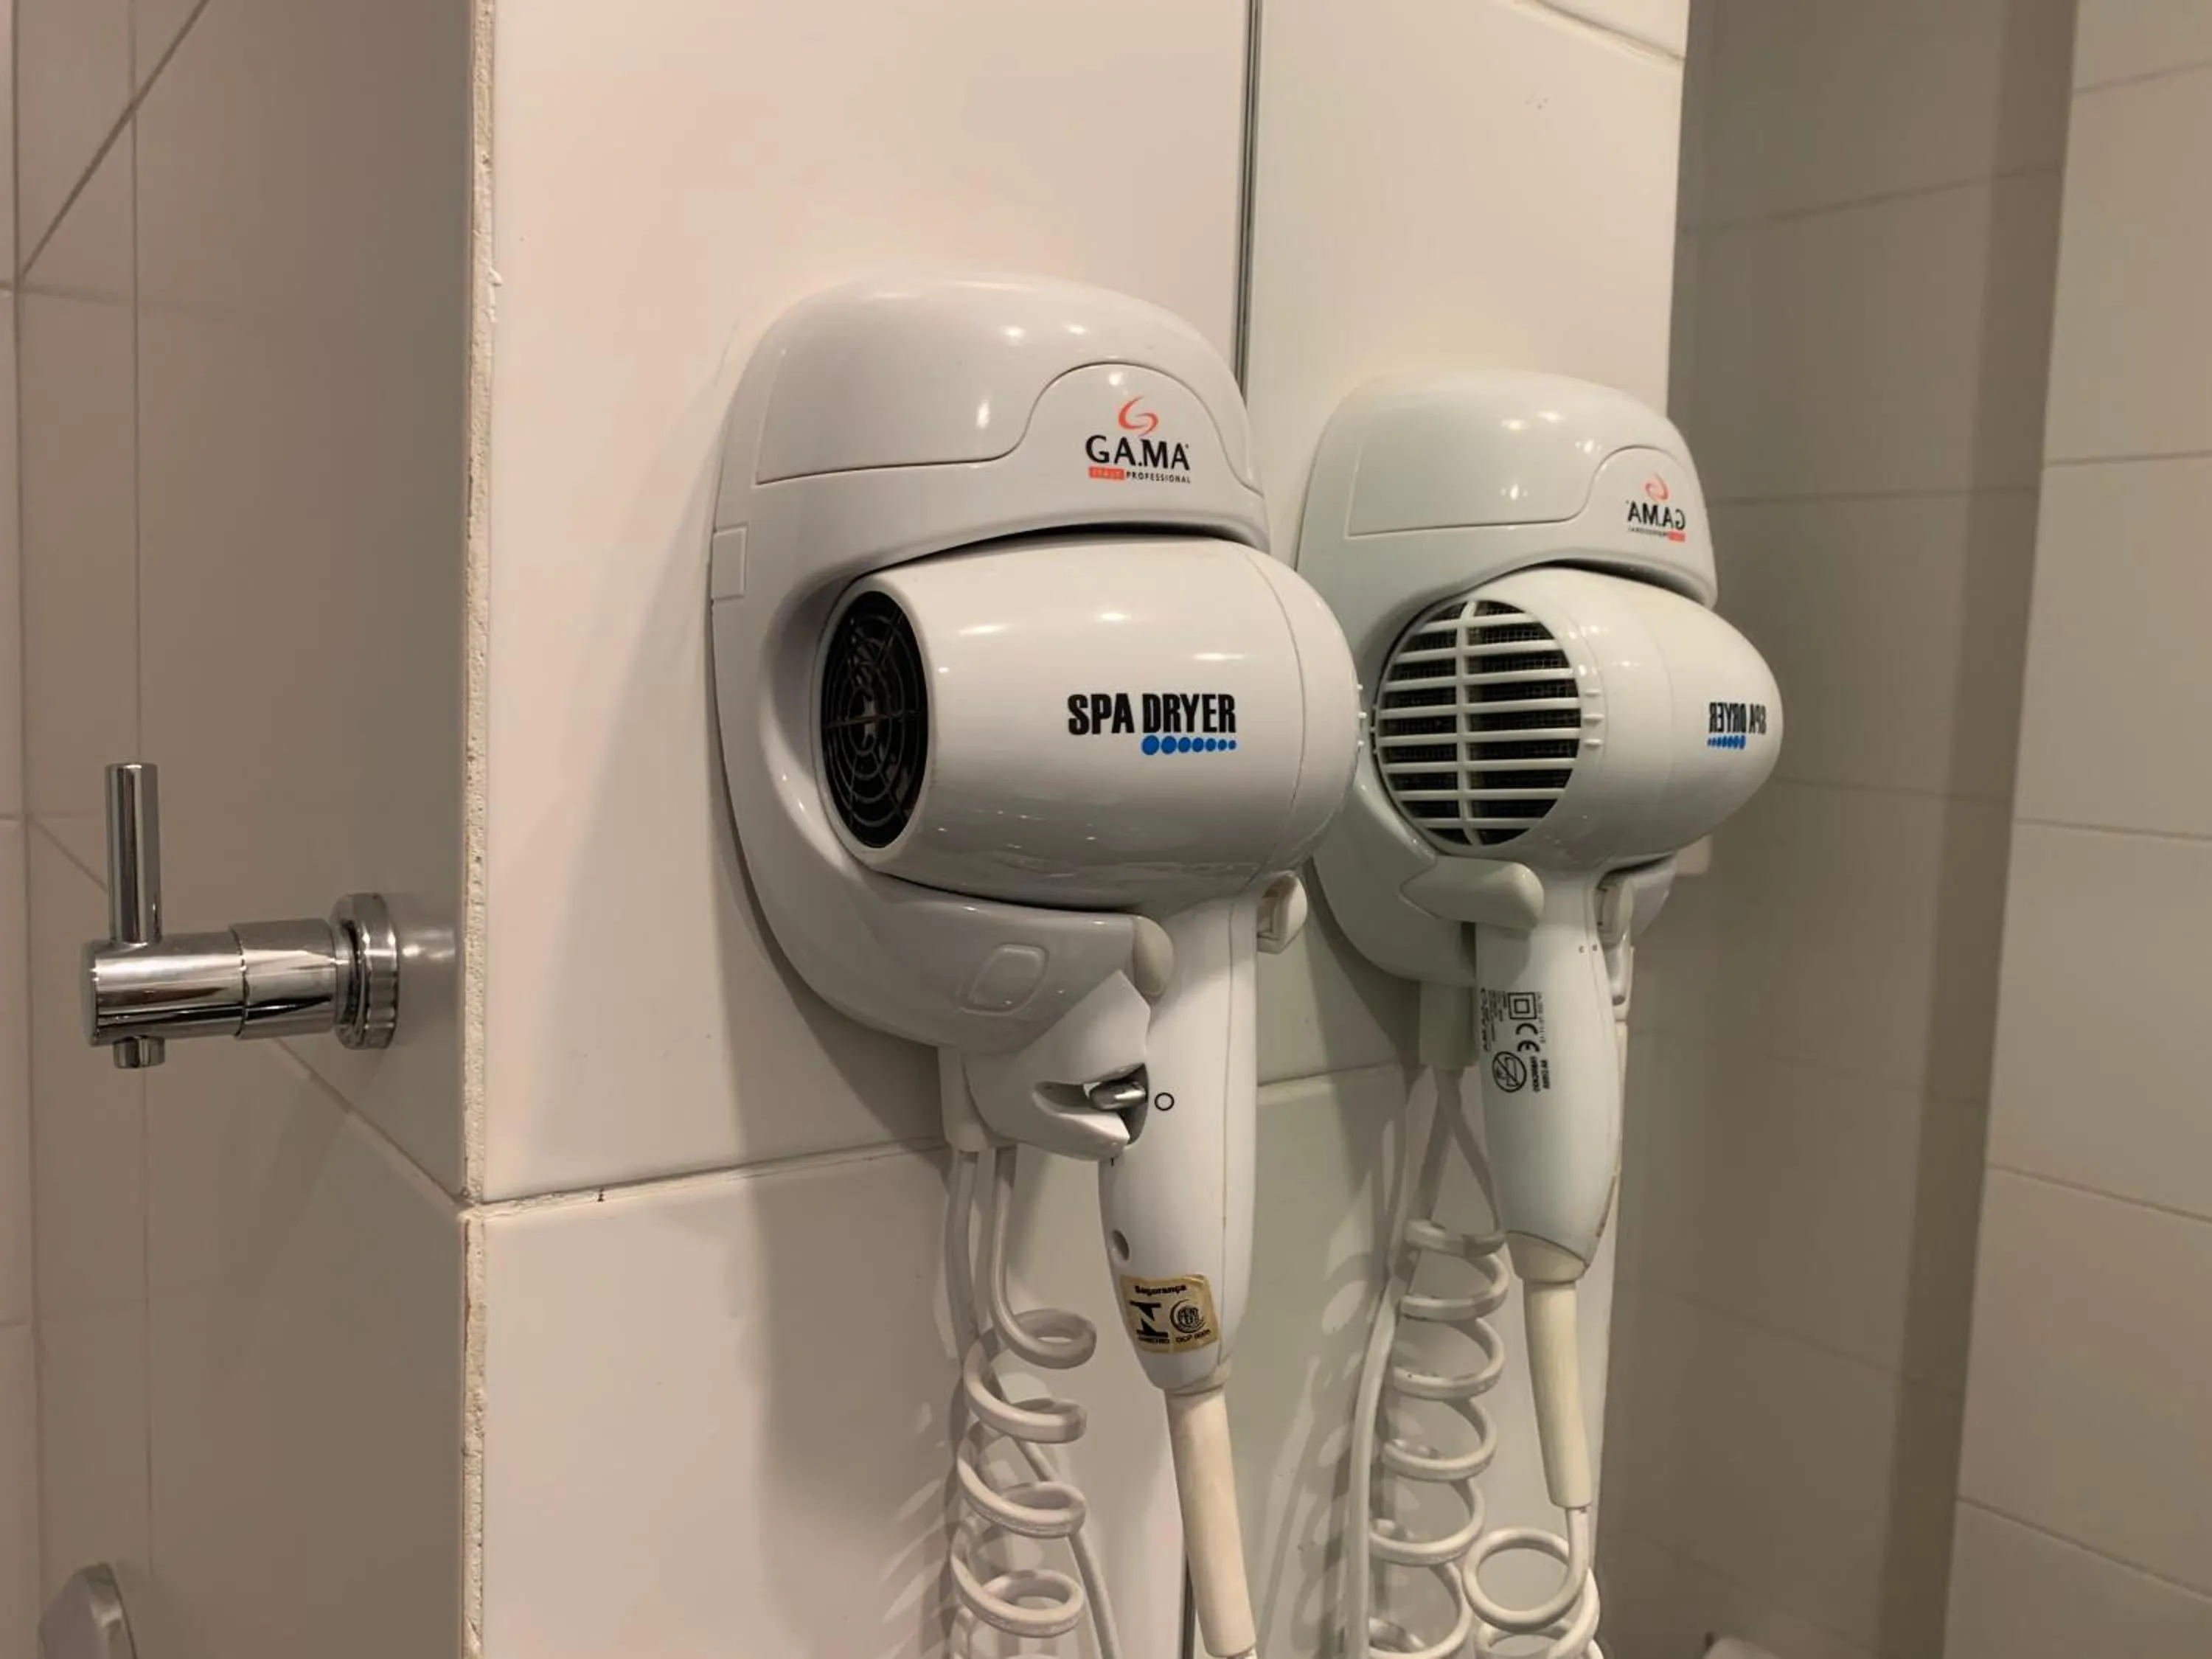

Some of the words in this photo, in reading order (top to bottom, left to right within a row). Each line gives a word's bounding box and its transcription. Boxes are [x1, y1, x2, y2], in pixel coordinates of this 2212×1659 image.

[1126, 471, 1191, 484] PROFESSIONAL
[1068, 693, 1135, 734] SPA
[1142, 693, 1237, 734] DRYER
